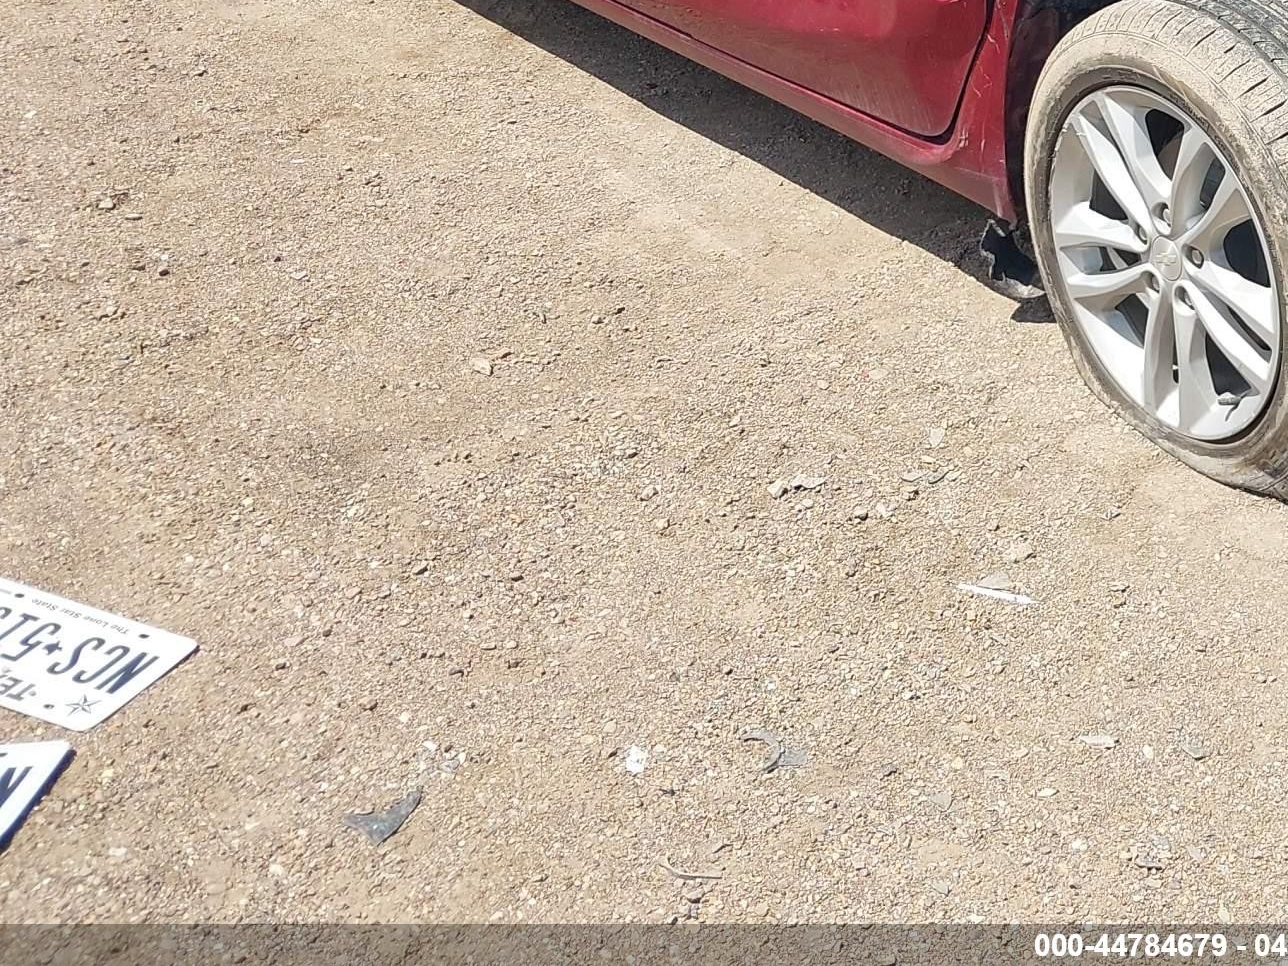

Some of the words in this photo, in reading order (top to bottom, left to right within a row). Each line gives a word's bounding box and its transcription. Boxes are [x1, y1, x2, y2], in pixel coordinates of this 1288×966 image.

[31, 598, 60, 611] State
[60, 607, 82, 619] Star
[84, 615, 110, 629] Lone
[111, 624, 131, 635] The
